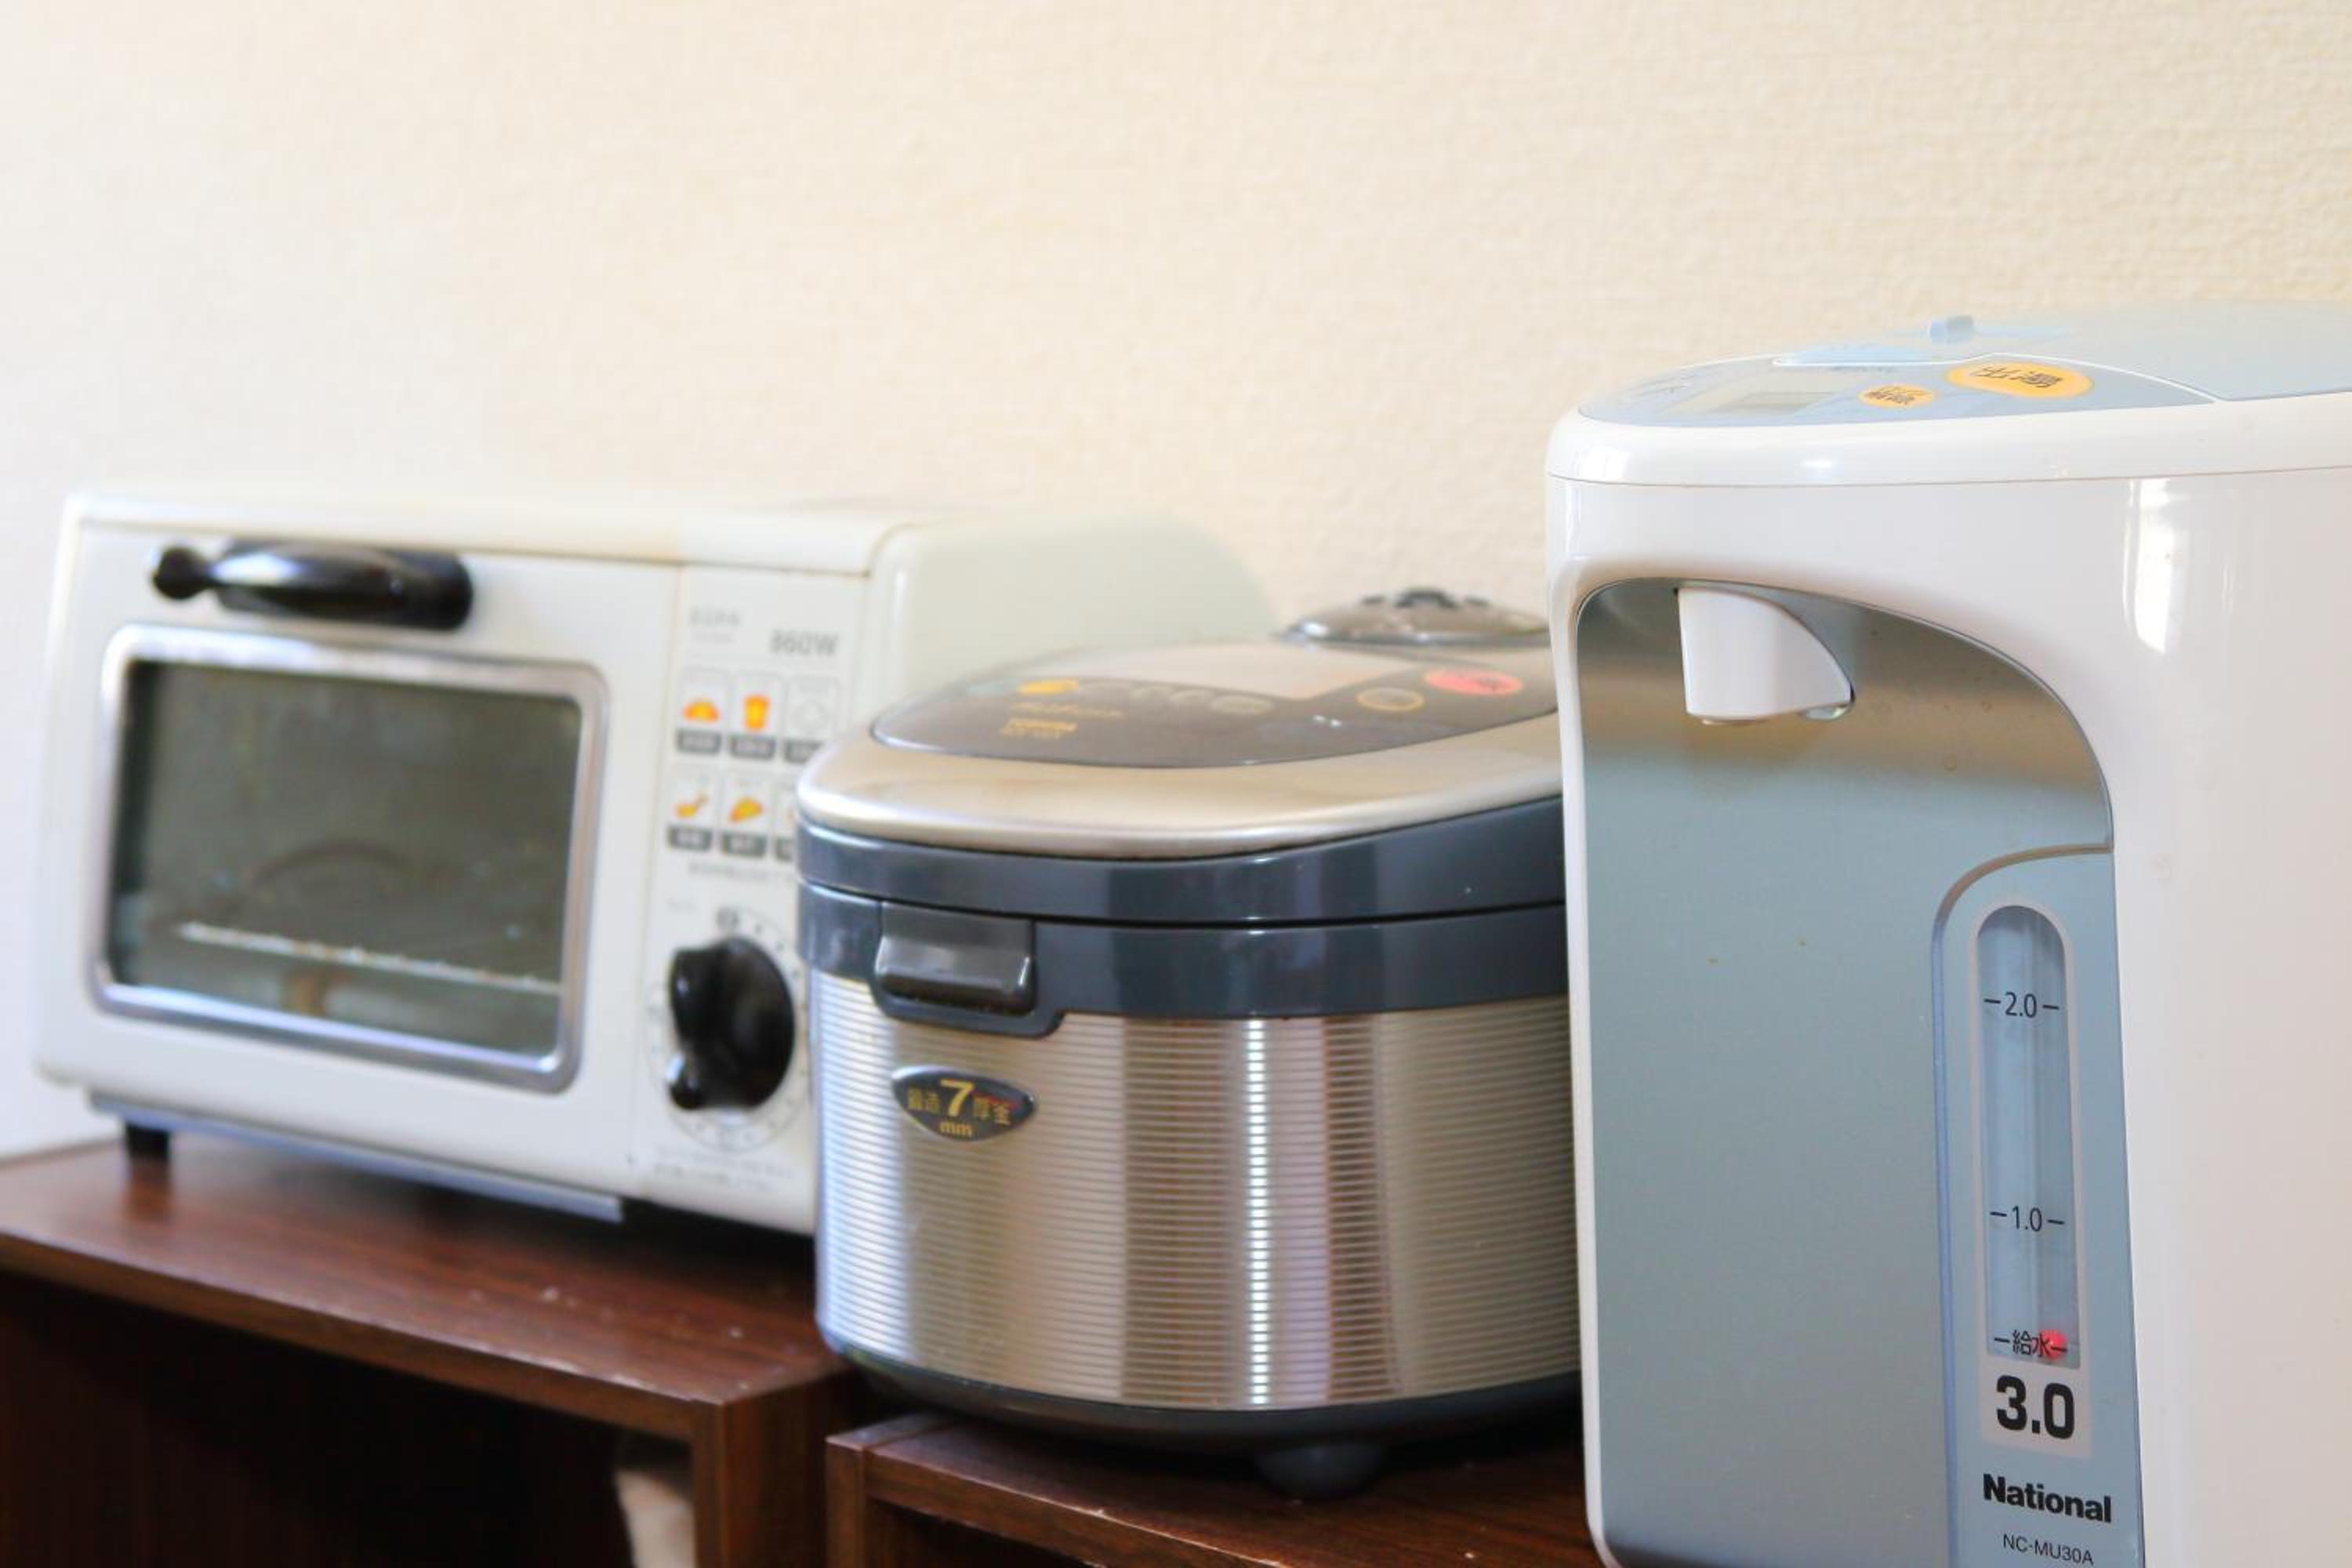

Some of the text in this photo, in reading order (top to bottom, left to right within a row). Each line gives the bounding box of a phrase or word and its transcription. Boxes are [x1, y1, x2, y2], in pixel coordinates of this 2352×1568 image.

[2005, 992, 2038, 1018] 2.0
[940, 1079, 975, 1117] 7
[2012, 1206, 2042, 1232] 1.0
[2013, 1330, 2053, 1358] 給水
[1996, 1374, 2074, 1440] 3.0
[1983, 1473, 2112, 1523] National
[2003, 1534, 2095, 1566] NC-MU30A
